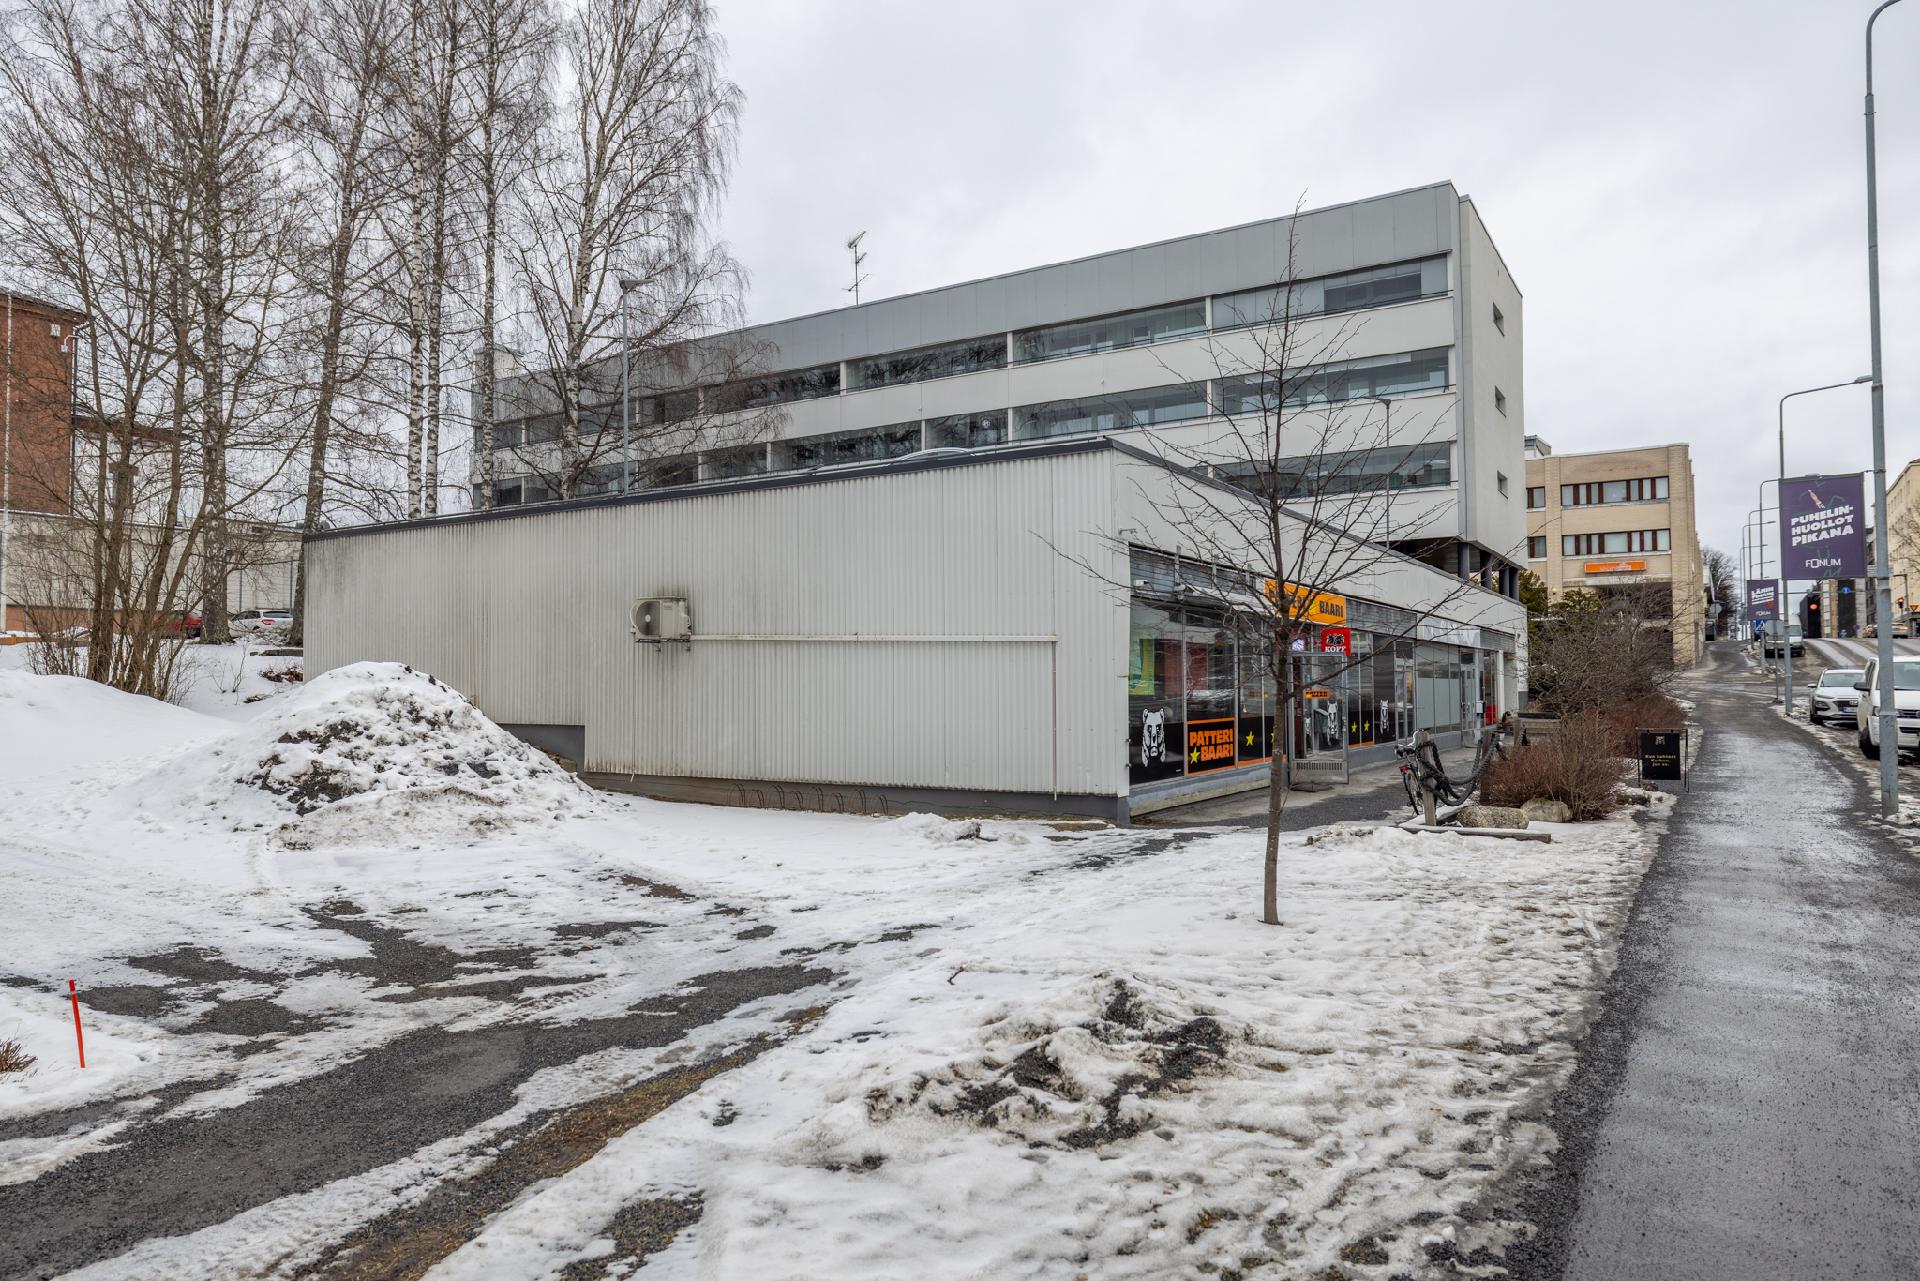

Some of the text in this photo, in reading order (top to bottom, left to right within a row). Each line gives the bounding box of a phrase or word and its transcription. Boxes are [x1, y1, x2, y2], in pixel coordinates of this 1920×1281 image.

[1791, 505, 1854, 526] PUHELIN-
[1792, 515, 1854, 535] HUOLLOT
[1792, 525, 1854, 546] PIKANA
[1319, 600, 1344, 618] BAARI
[1325, 645, 1346, 653] KOFF
[1189, 729, 1233, 747] PATTERI
[1200, 743, 1233, 762] BAARI
